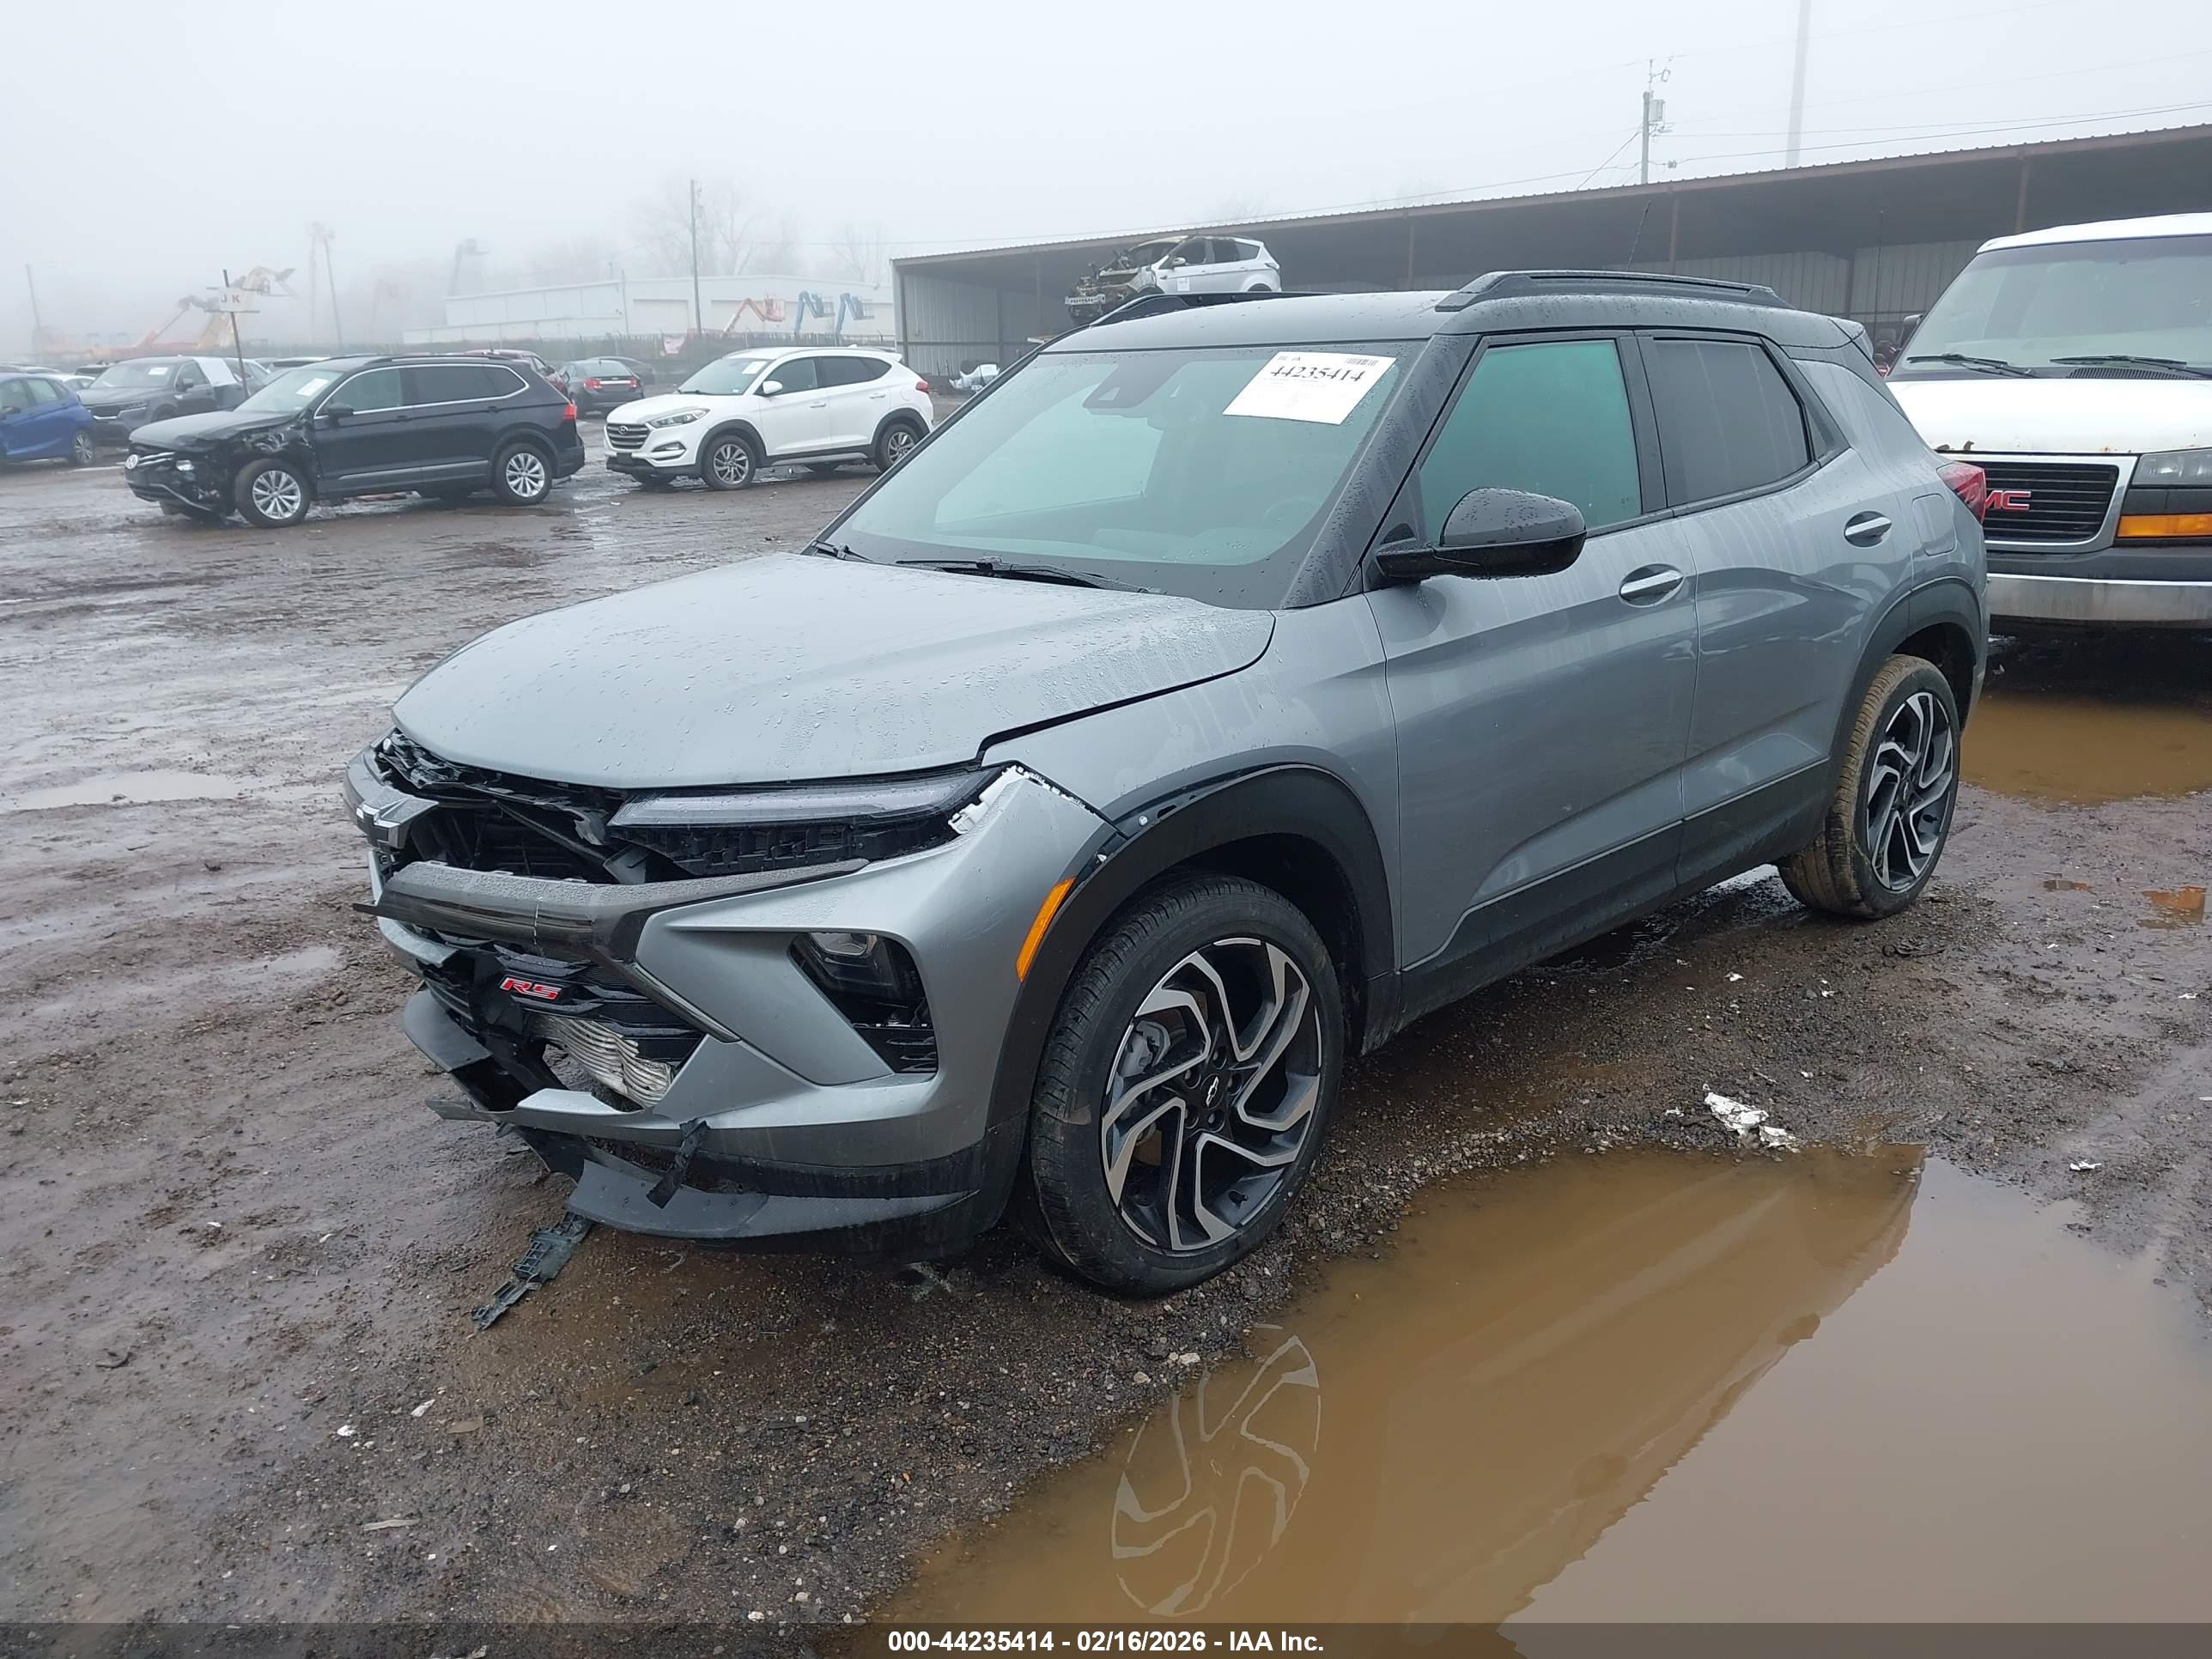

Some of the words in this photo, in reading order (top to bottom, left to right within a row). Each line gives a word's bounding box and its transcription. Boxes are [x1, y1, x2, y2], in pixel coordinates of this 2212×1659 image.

[1271, 366, 1365, 382] 44235414
[1984, 490, 2032, 510] MC
[500, 977, 562, 1000] RS
